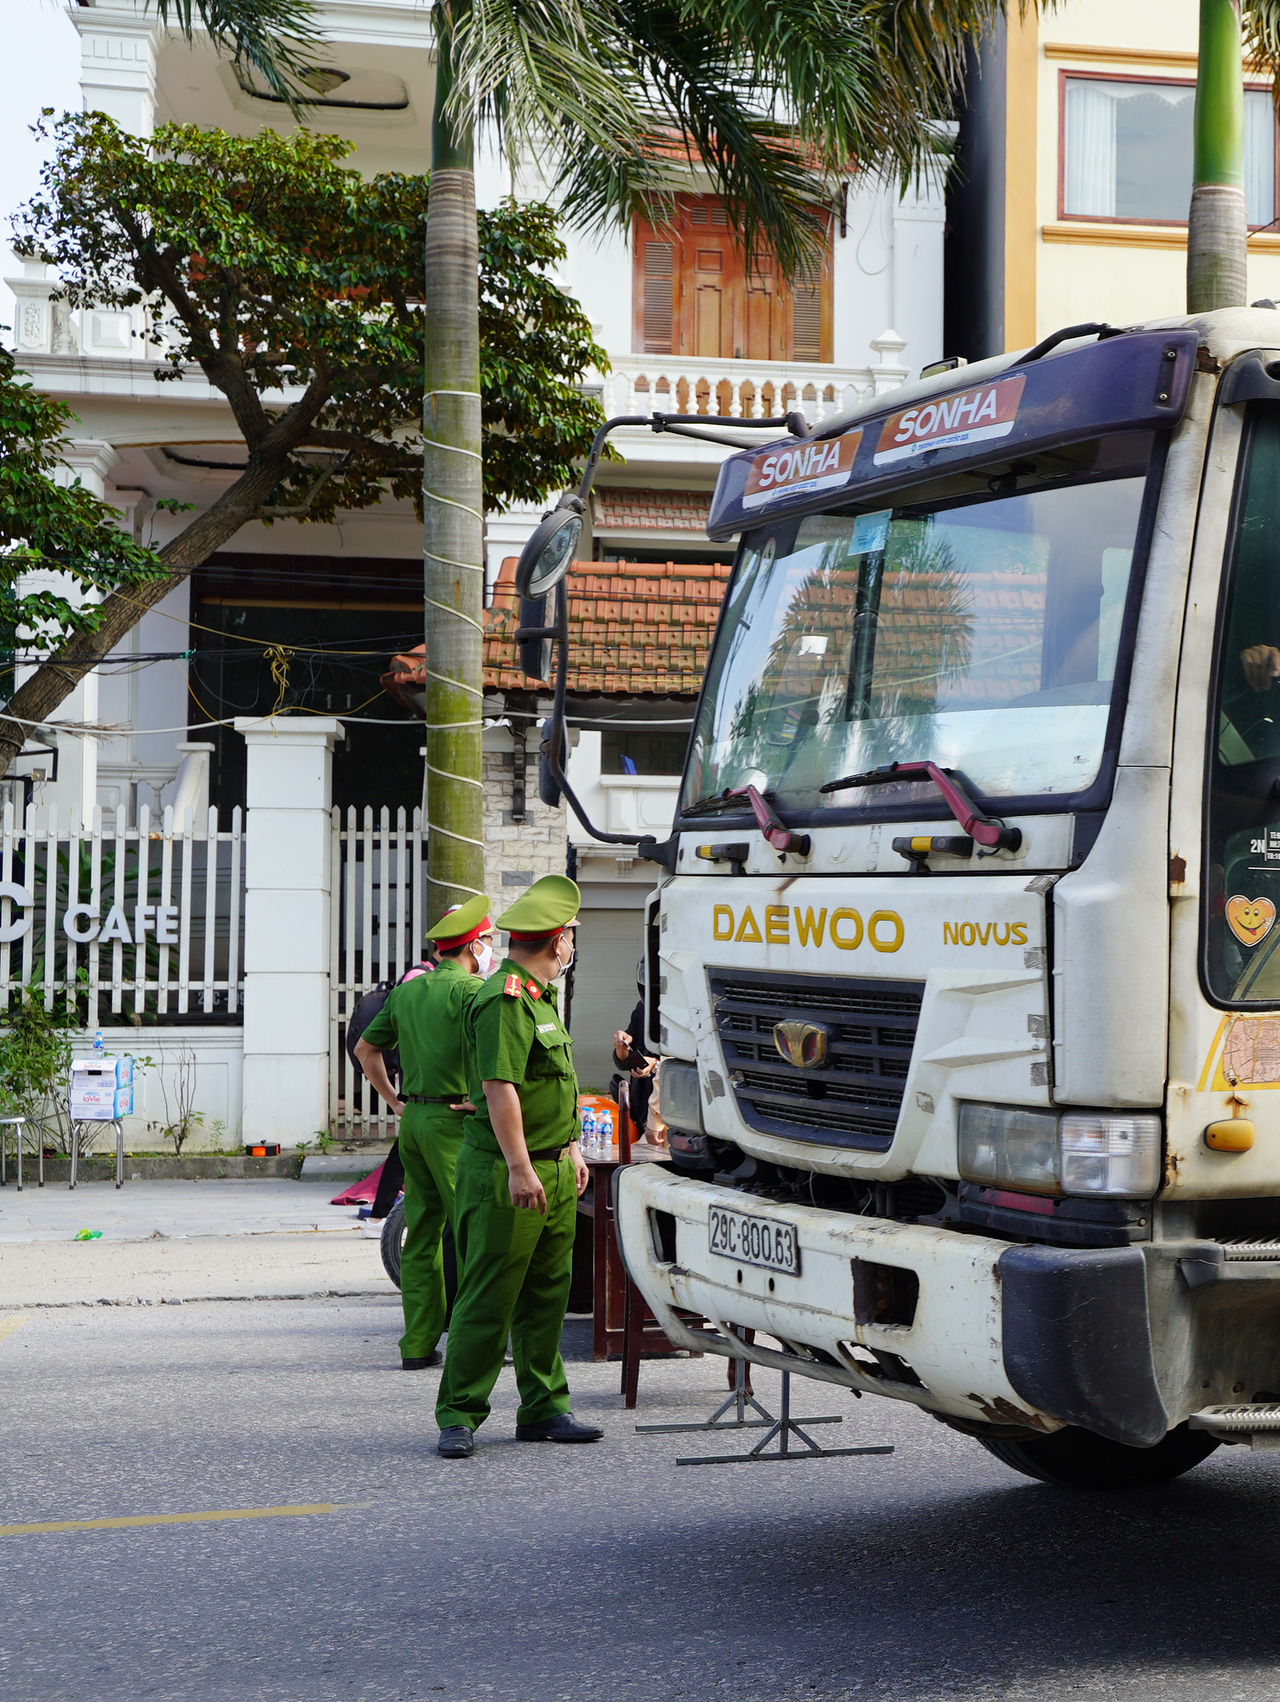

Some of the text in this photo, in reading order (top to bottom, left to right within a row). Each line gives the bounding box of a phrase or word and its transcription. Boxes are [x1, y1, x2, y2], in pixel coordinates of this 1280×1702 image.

[894, 389, 997, 443] SONHA
[758, 441, 841, 487] SONHA
[1250, 839, 1266, 853] 2N
[63, 903, 178, 944] CAFE
[713, 904, 1028, 953] DAEWOO NOVUS
[711, 1211, 793, 1267] 29C-800.63
